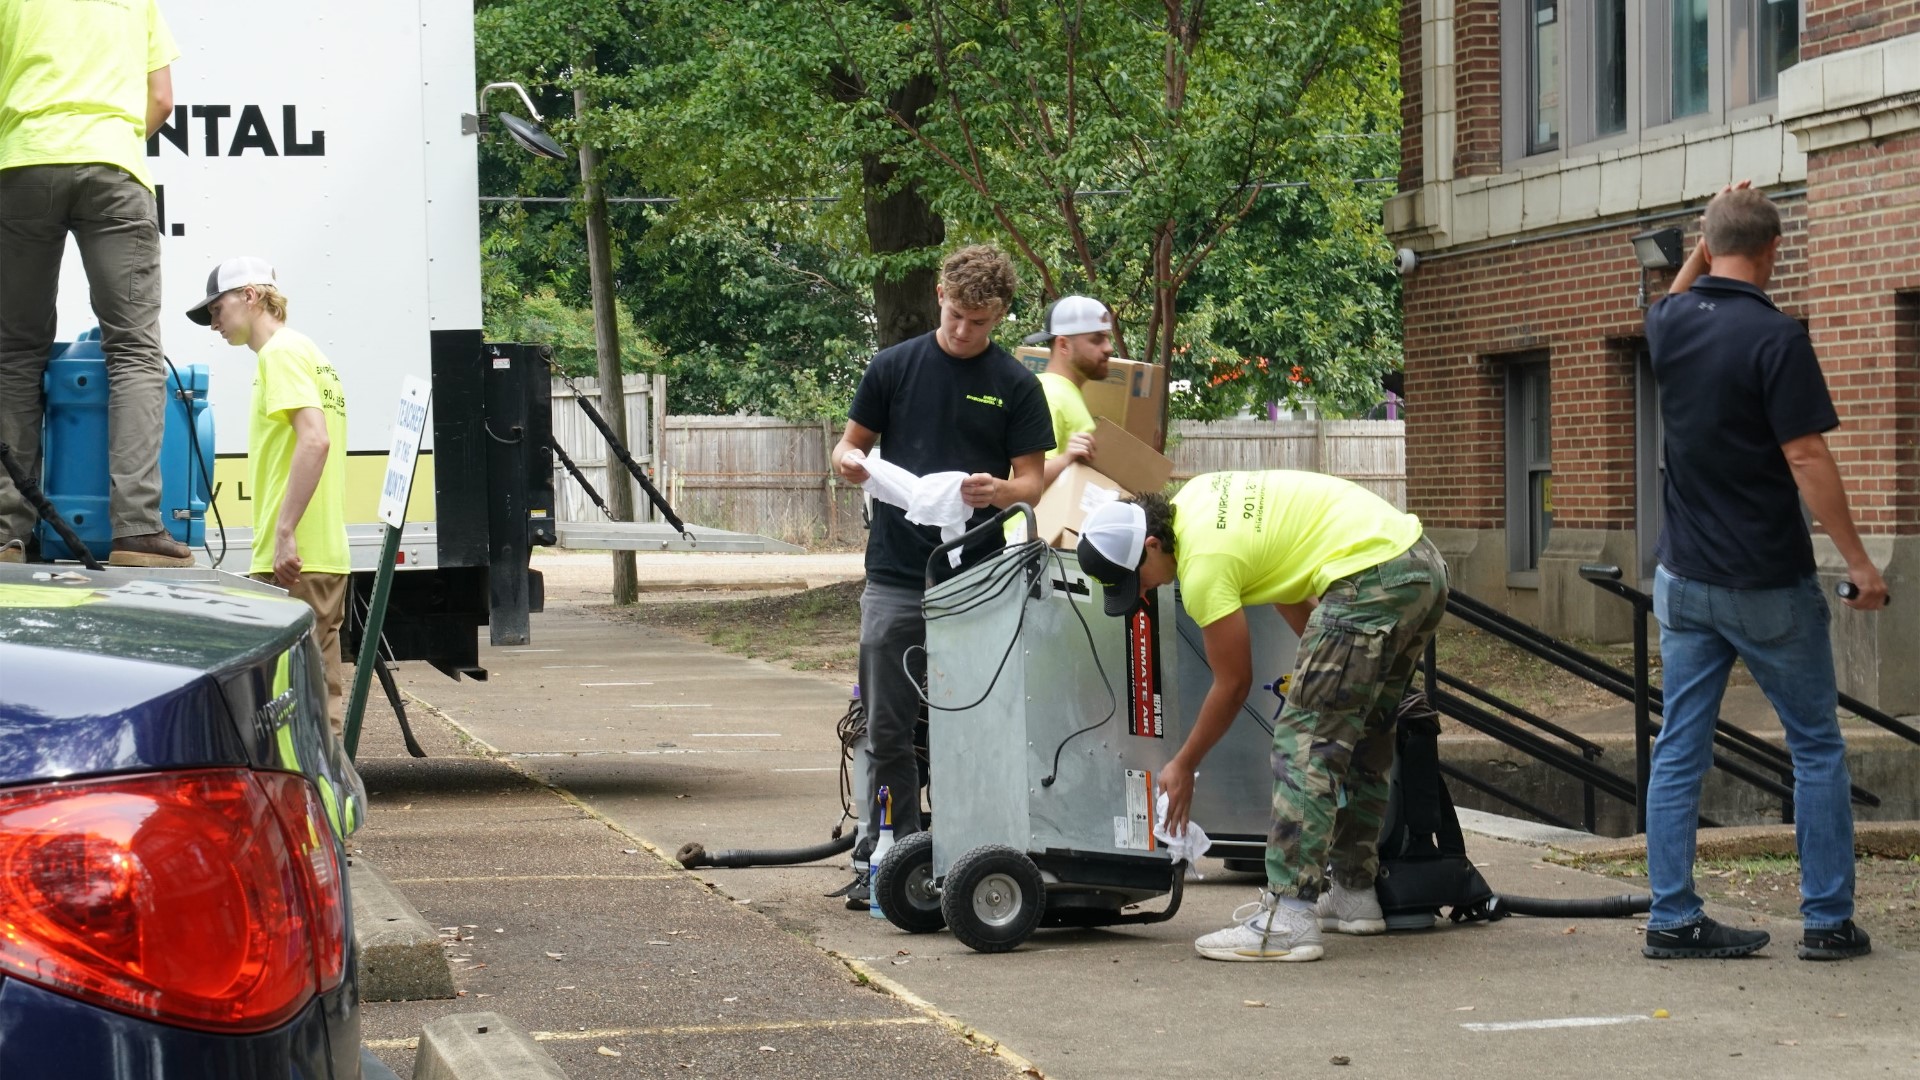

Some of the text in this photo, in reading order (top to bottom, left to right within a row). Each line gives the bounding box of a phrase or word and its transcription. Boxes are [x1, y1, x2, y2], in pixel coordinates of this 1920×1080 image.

[397, 399, 425, 433] TEACHER
[401, 439, 412, 463] THE
[384, 469, 408, 503] MONTH
[1139, 611, 1149, 702] ULTIMATE
[1153, 693, 1162, 736] HEPA 1000
